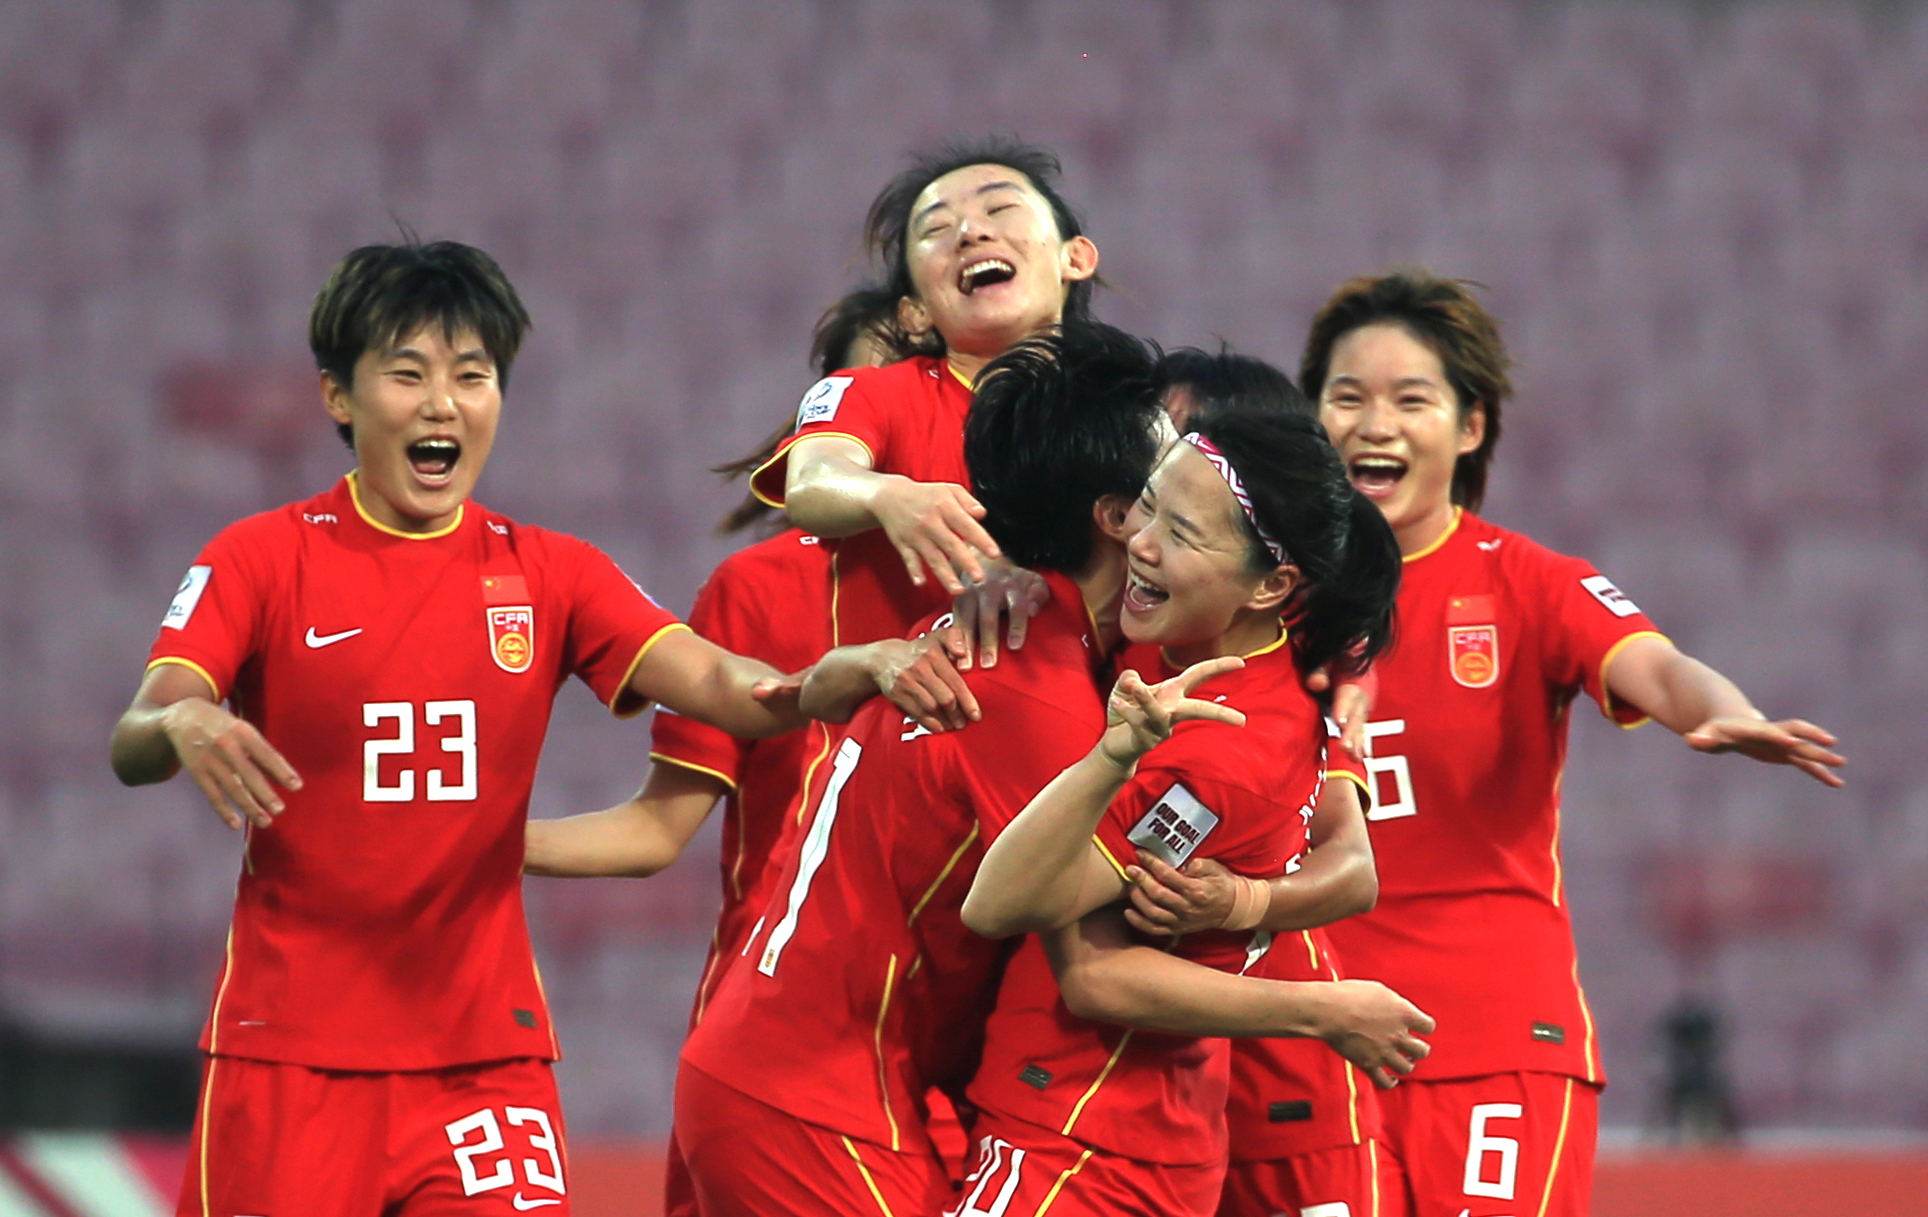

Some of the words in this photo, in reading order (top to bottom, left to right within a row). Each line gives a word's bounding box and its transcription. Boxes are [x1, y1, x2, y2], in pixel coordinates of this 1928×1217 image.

[493, 612, 530, 625] CFA
[362, 699, 479, 802] 23
[1366, 718, 1418, 821] 6
[1148, 817, 1171, 840] FOR
[1165, 834, 1186, 854] ALL
[1156, 803, 1179, 825] OUR
[1174, 820, 1200, 844] GOAL
[444, 1106, 567, 1198] 23
[1462, 1103, 1524, 1200] 6
